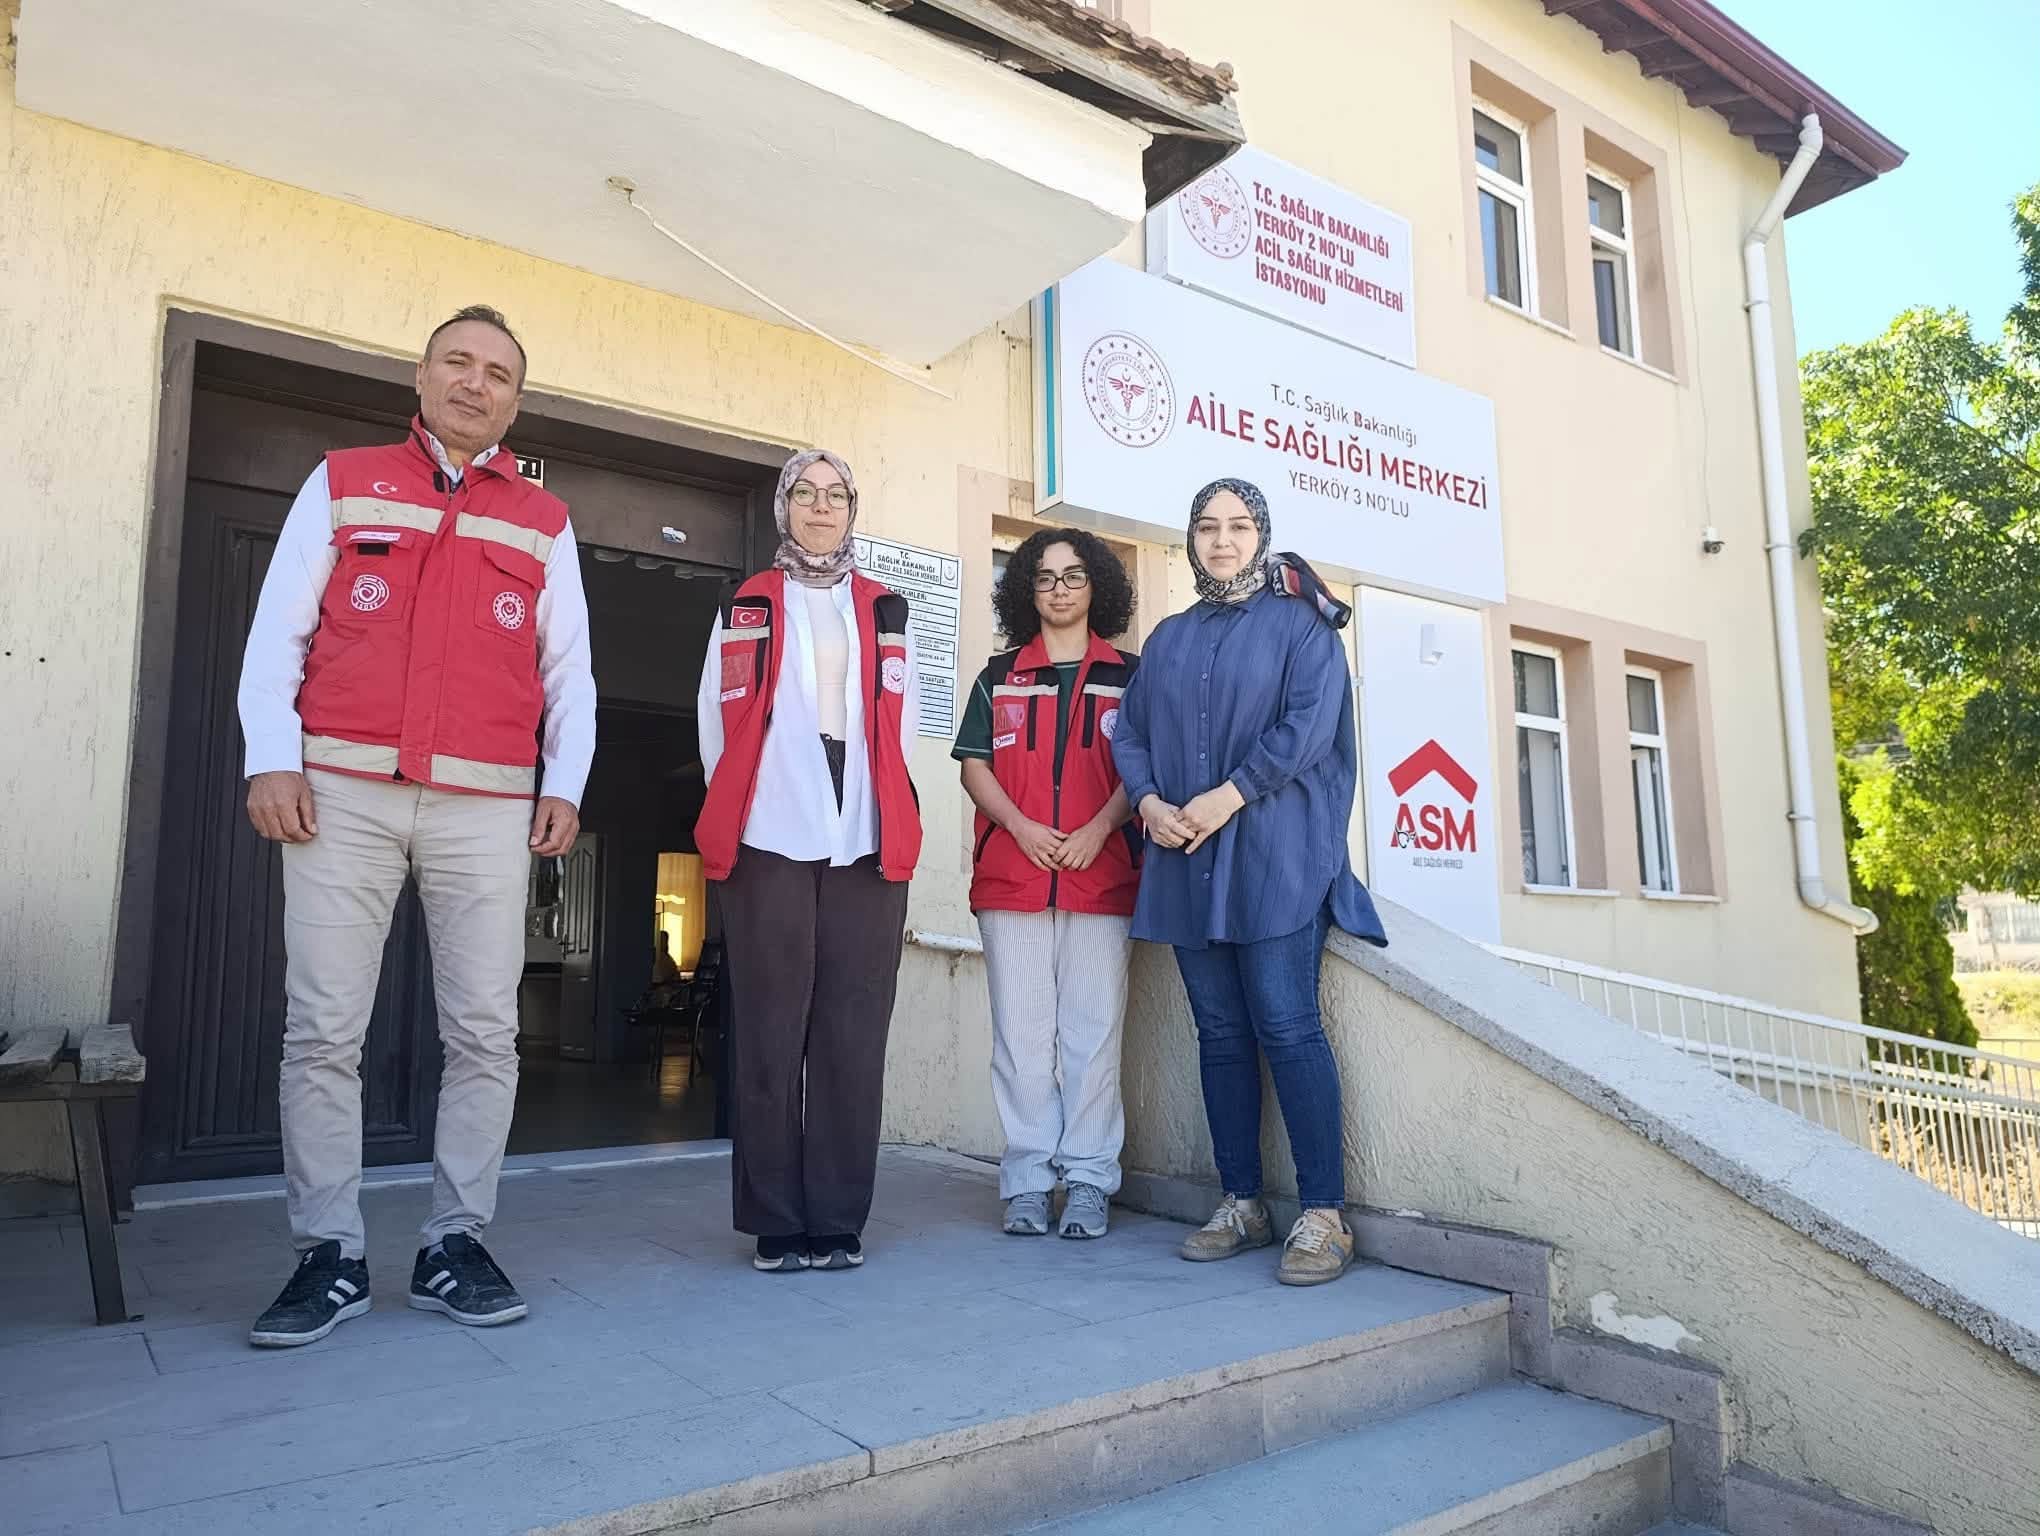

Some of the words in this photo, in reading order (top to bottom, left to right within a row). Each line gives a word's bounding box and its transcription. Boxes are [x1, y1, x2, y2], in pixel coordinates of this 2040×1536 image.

[1253, 182, 1277, 209] T.C.
[1280, 194, 1325, 230] SAĞLIK
[1328, 215, 1389, 259] BAKANLIĞI
[1254, 208, 1304, 243] YERKÖY
[1308, 233, 1316, 250] 2
[1319, 239, 1354, 268] NO'LU
[1255, 235, 1284, 262] ACİL
[1287, 248, 1332, 283] SAĞLIK
[1335, 268, 1403, 313] HİZMETLERİ
[1256, 257, 1326, 305] İSTASYONU
[1270, 383, 1300, 410] T.C.
[1304, 395, 1350, 426] Sağlık
[1353, 410, 1417, 447] Bakanlığı
[1186, 391, 1255, 443] AİLE
[1264, 419, 1372, 476] SAĞLIĞI
[1380, 453, 1488, 510] MERKEZİ
[1289, 469, 1351, 503] YERKÖY
[1353, 487, 1362, 505] 3
[1367, 494, 1410, 518] NO'LU
[1391, 802, 1478, 853] ASM
